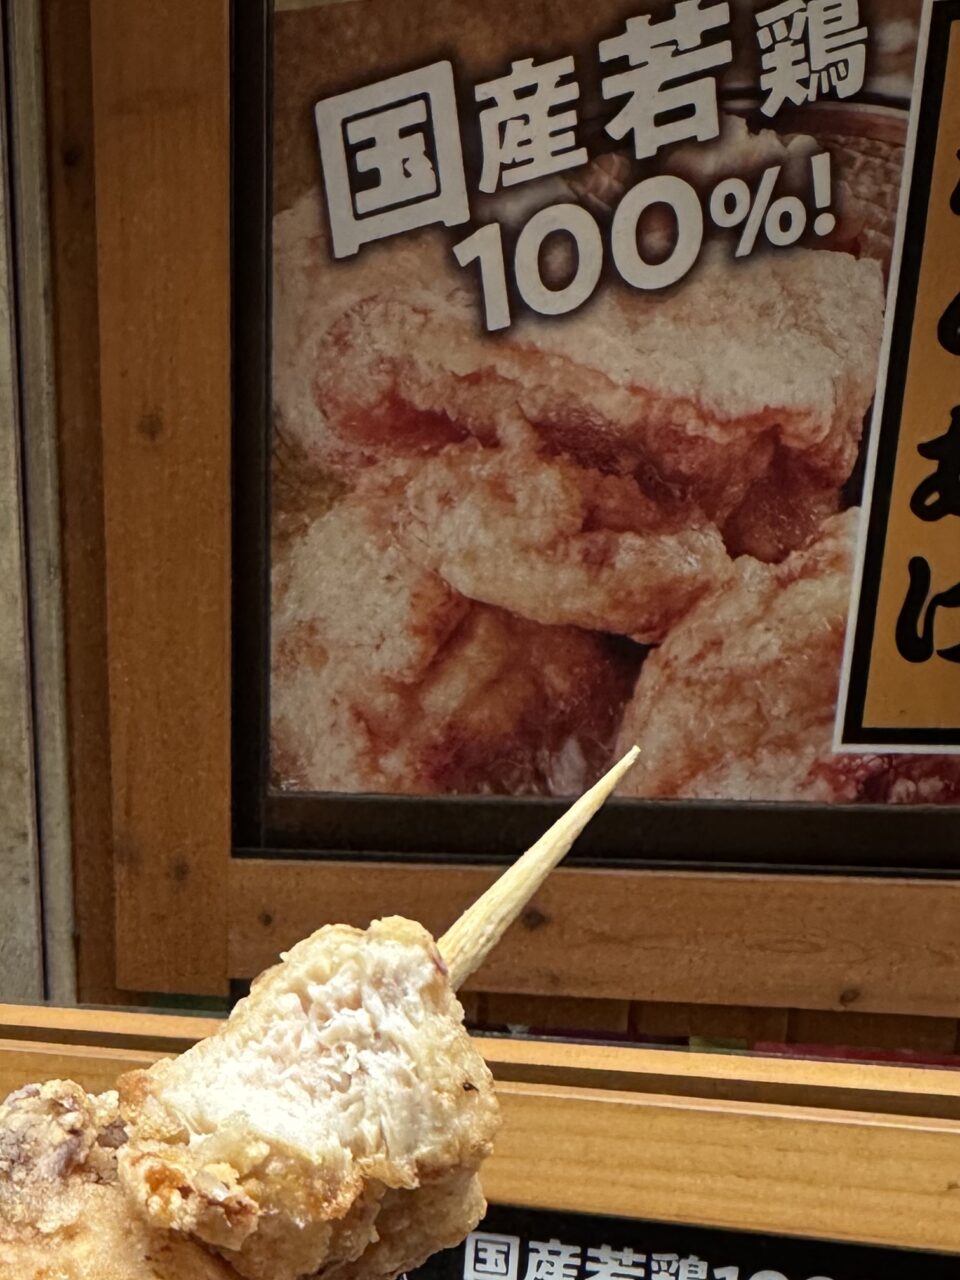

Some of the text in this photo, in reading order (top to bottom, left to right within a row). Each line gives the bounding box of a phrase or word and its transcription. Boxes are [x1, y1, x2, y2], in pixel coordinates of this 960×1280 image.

[315, 0, 868, 260] 国産若鶏
[452, 152, 837, 332] 100%!
